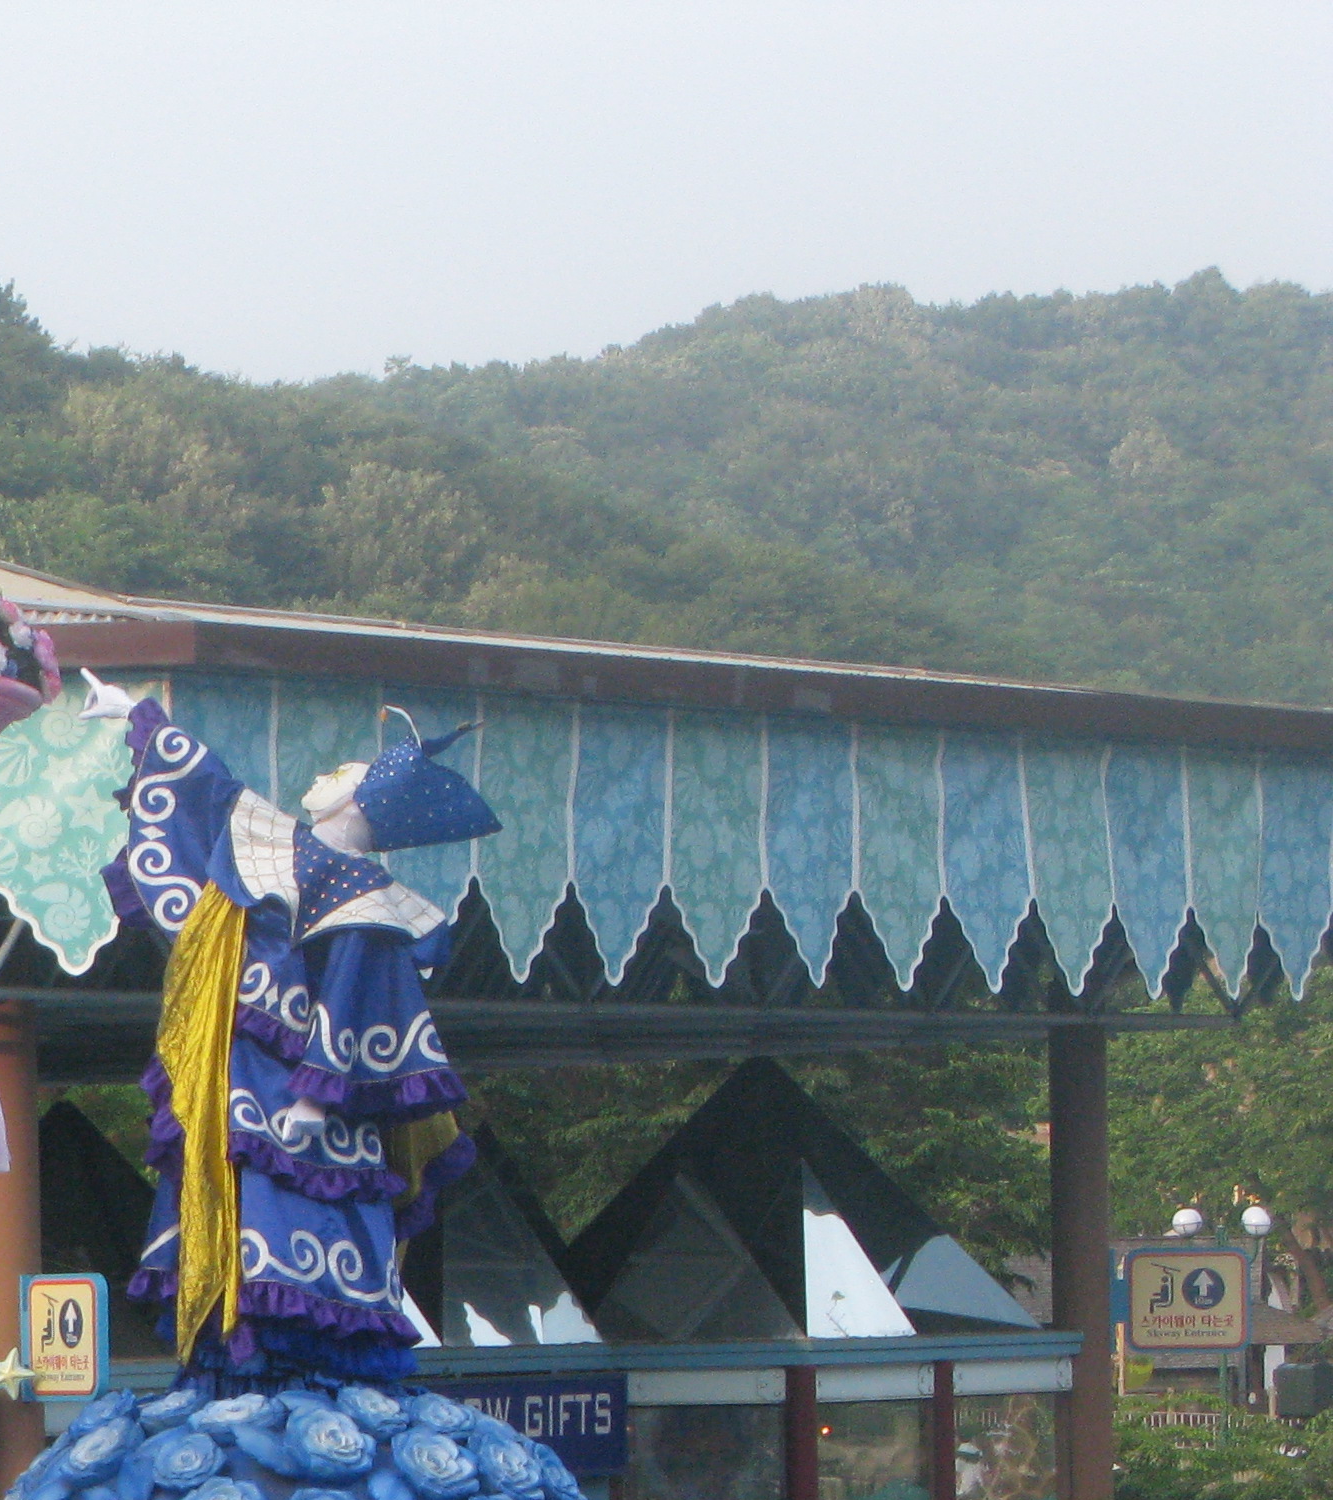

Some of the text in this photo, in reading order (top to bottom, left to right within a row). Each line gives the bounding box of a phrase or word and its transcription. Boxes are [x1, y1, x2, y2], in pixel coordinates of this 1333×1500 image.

[1141, 1314, 1234, 1328] 스카이웨이 타는곳
[524, 1393, 612, 1437] GIFTS
